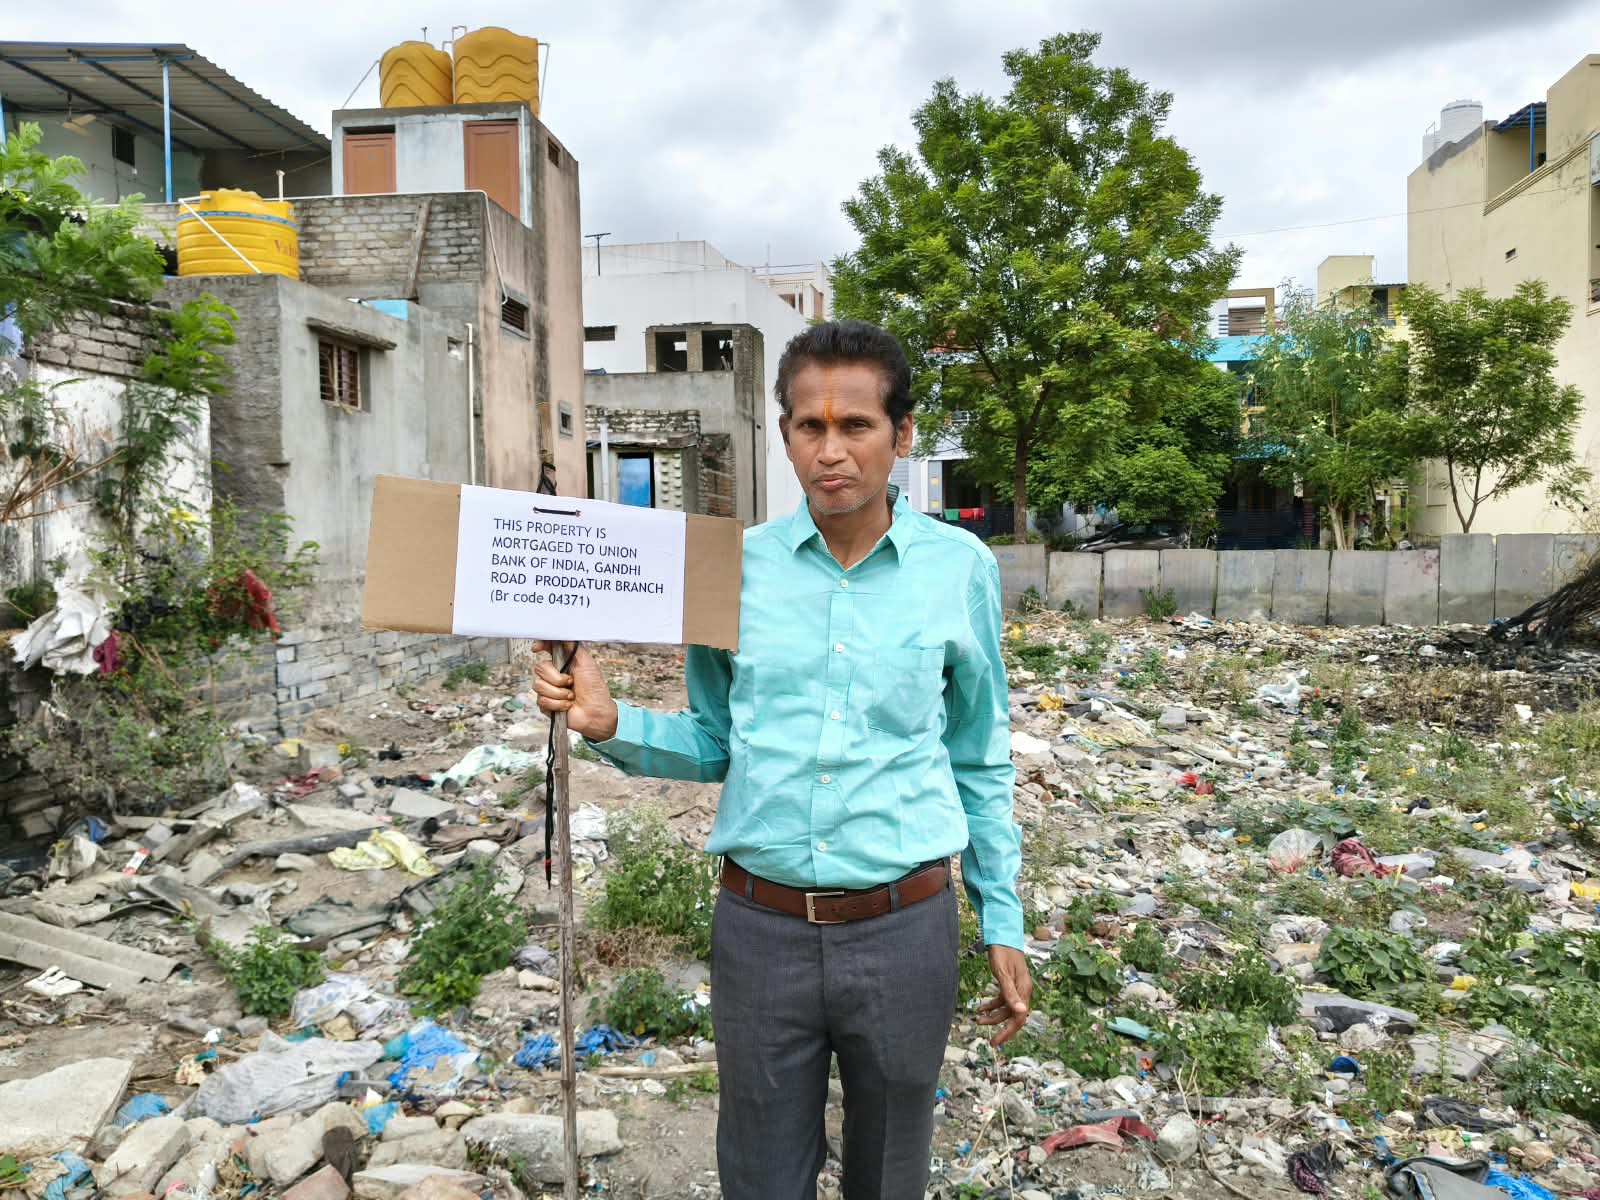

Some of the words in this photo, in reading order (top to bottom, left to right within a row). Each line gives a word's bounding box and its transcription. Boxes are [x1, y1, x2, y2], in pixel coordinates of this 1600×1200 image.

[494, 518, 523, 532] THIS
[526, 521, 592, 538] PROPERTY
[596, 528, 607, 539] IS
[492, 537, 574, 553] MORTGAGED
[577, 543, 595, 555] TO
[599, 545, 638, 558] UNION
[491, 553, 526, 568] BANK
[530, 557, 548, 569] OF
[552, 559, 590, 574] INDIA,
[594, 562, 641, 576] GANDHI
[491, 572, 527, 585] ROAD
[535, 575, 611, 591] PRODDATUR
[615, 581, 664, 595] BRANCH
[490, 590, 510, 604] (Br
[513, 592, 544, 604] code
[548, 593, 591, 608] 04371)
